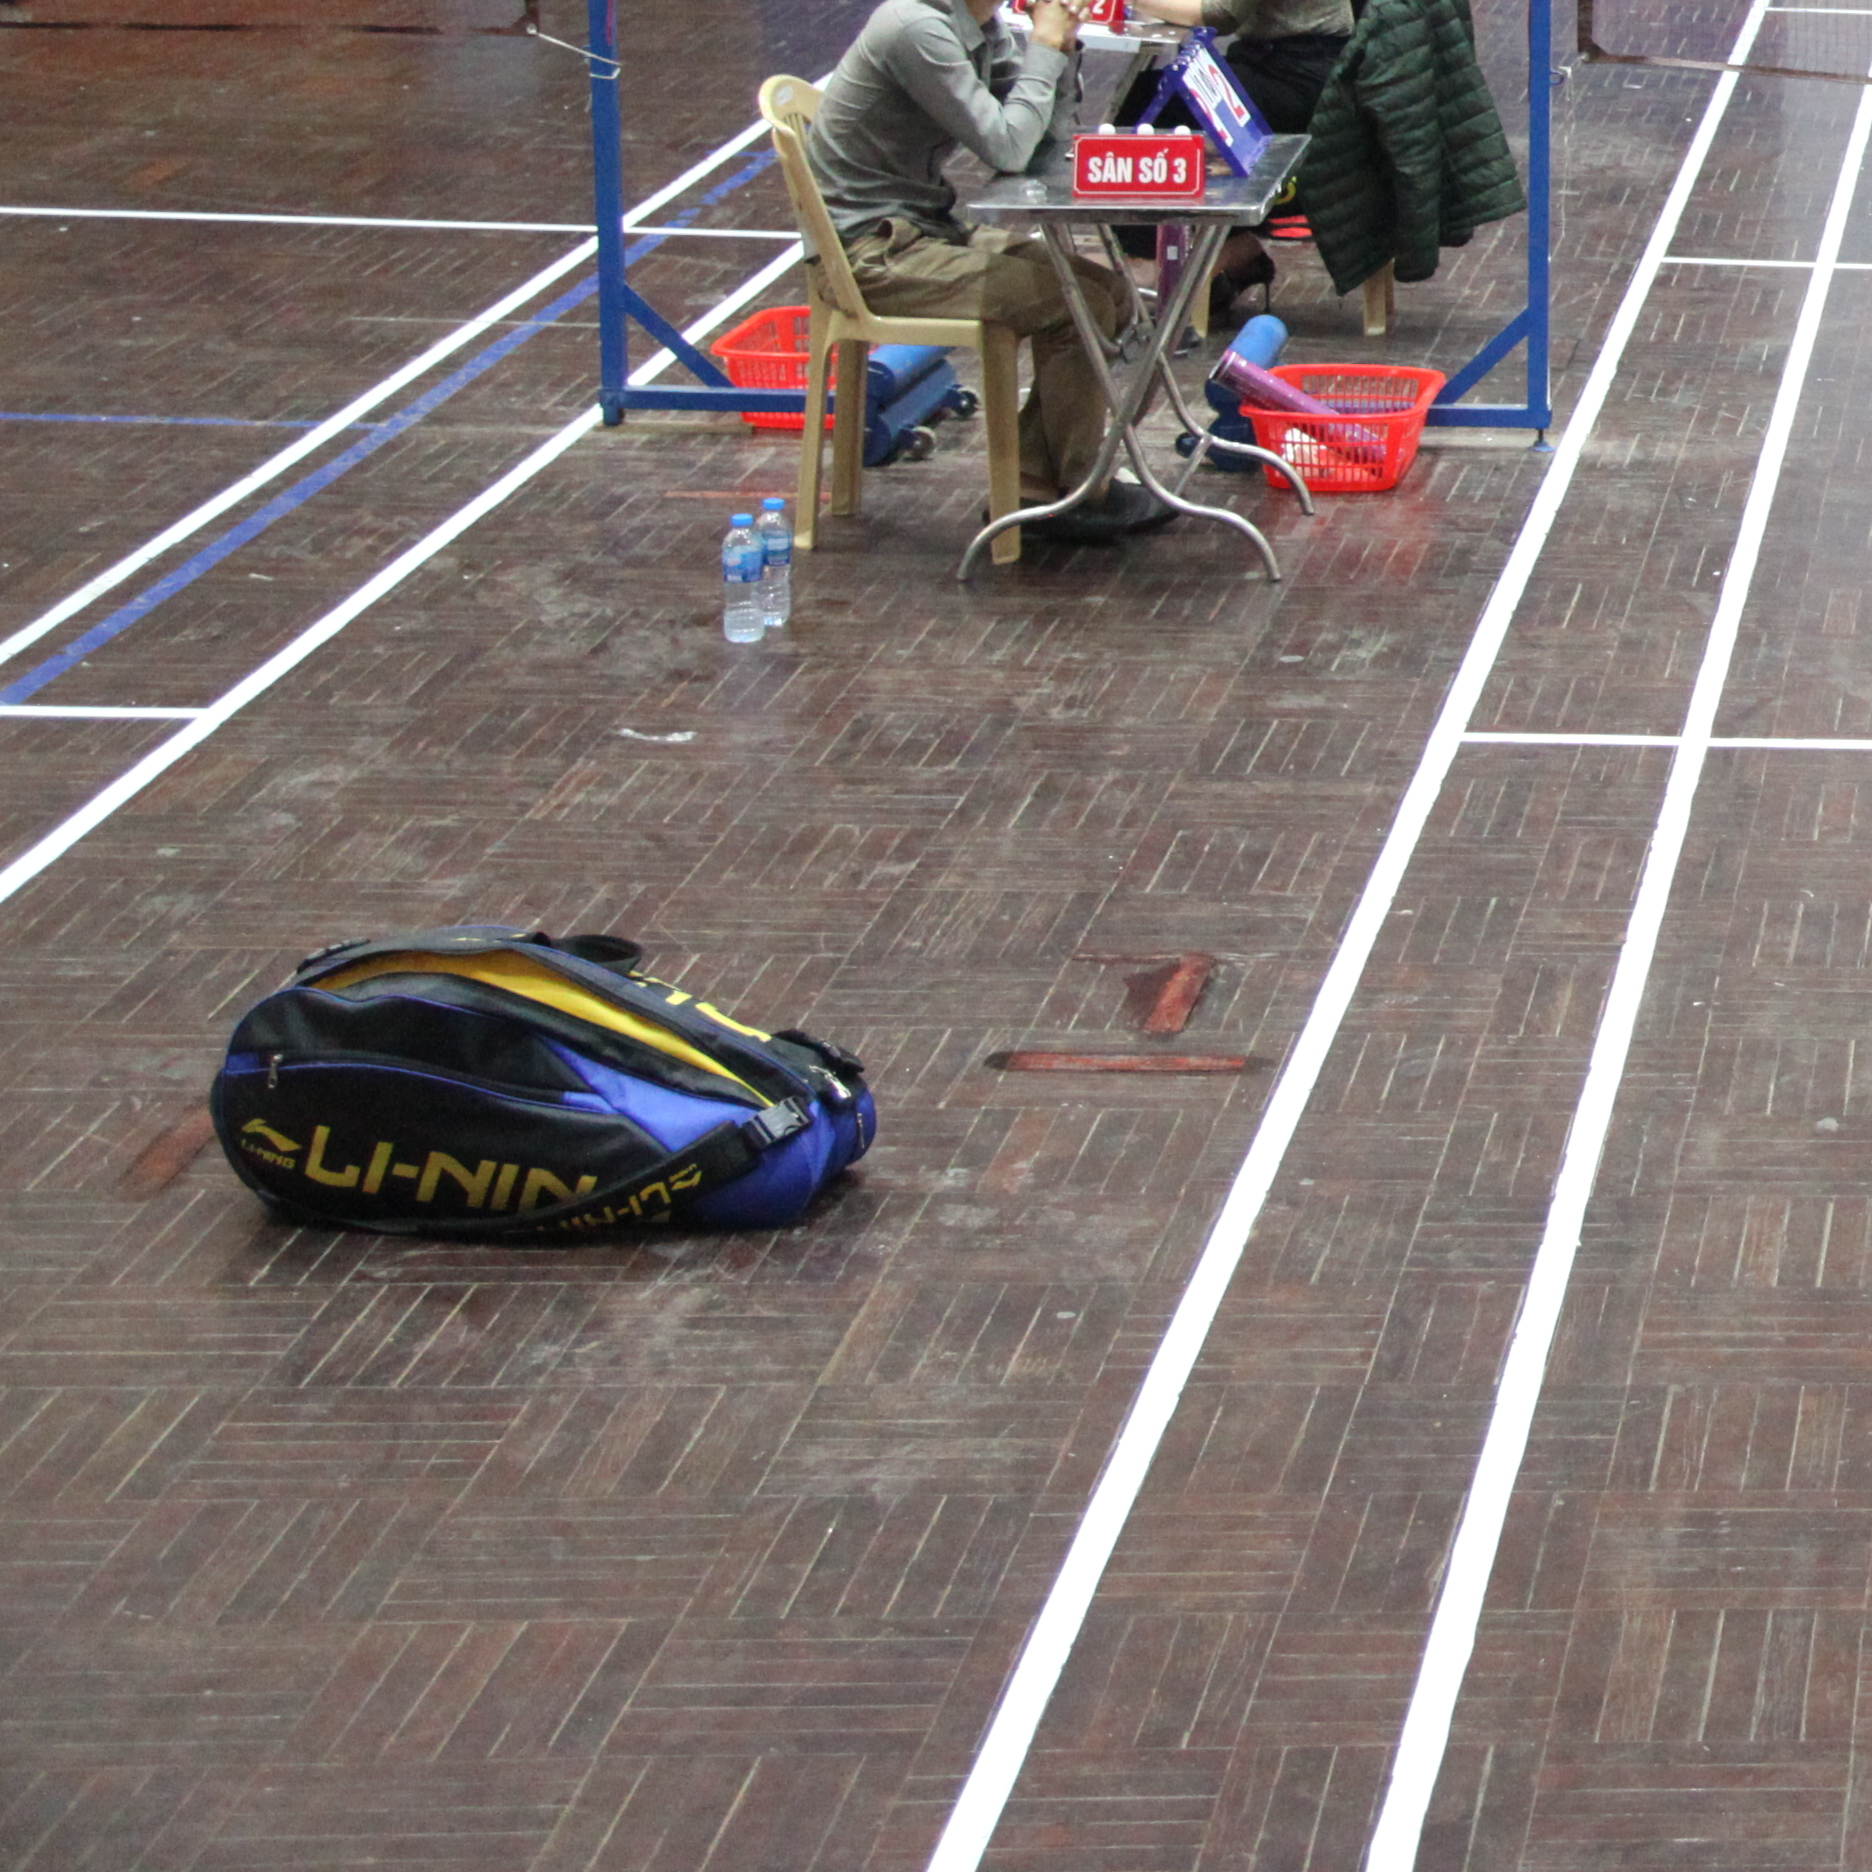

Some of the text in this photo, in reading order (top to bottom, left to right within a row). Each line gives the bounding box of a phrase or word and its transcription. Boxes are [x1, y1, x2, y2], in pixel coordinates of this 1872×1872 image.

[1087, 148, 1188, 183] SÂN SỐ 3
[304, 1125, 599, 1215] LI-NIN
